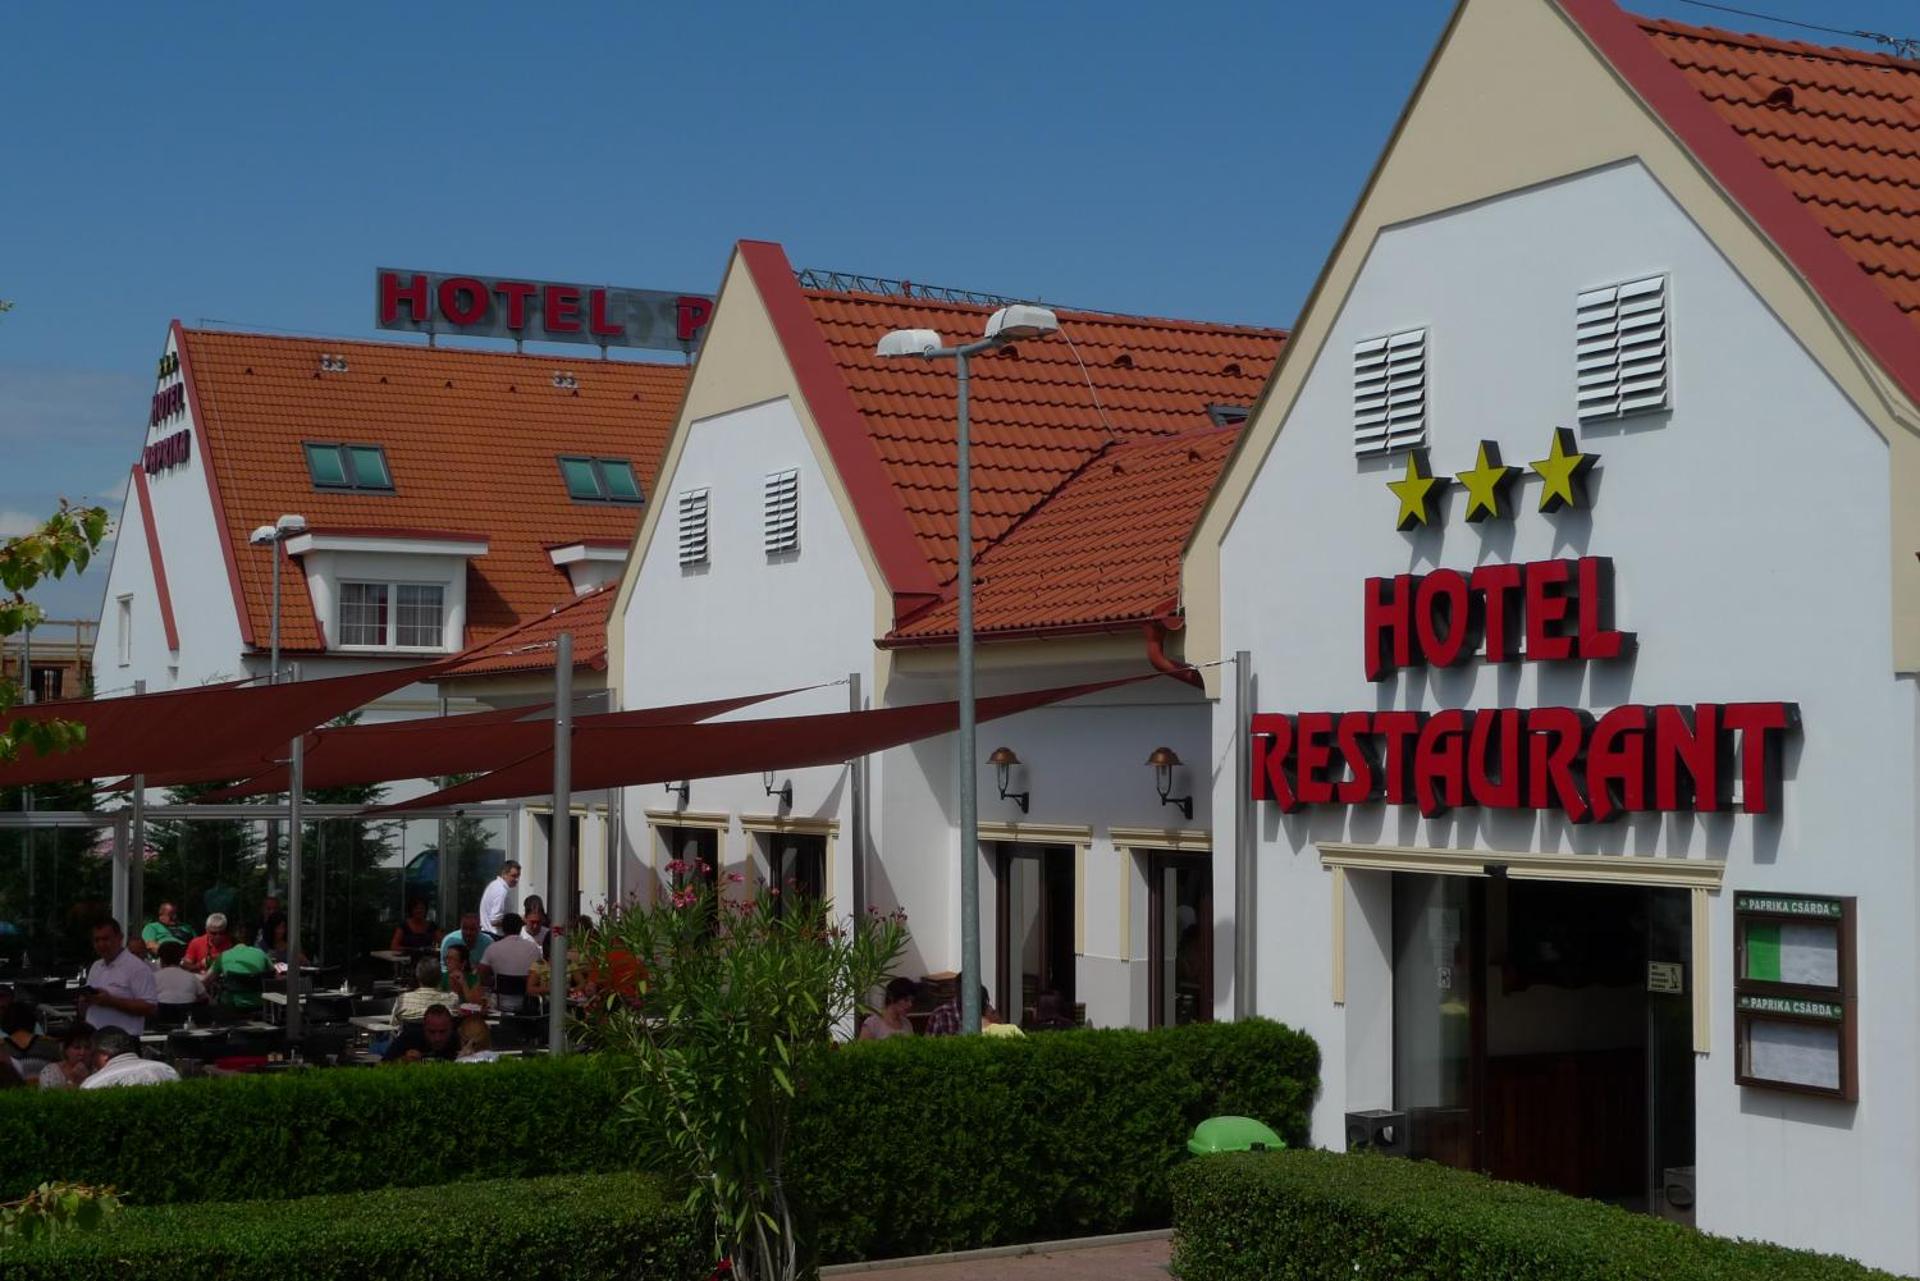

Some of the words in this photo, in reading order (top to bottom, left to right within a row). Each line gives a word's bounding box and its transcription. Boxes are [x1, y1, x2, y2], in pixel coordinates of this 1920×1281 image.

[380, 272, 624, 336] HOTEL
[152, 381, 185, 427] HOTEL
[144, 428, 191, 475] PAPRIKA
[1364, 556, 1636, 682] HOTEL
[1251, 702, 1795, 823] RESTAURANT
[1749, 899, 1788, 913] PAPRIKA
[1792, 901, 1830, 915] CSÁRDA
[1750, 998, 1791, 1013] PAPRIKA
[1792, 1001, 1832, 1016] CSÁRDA
